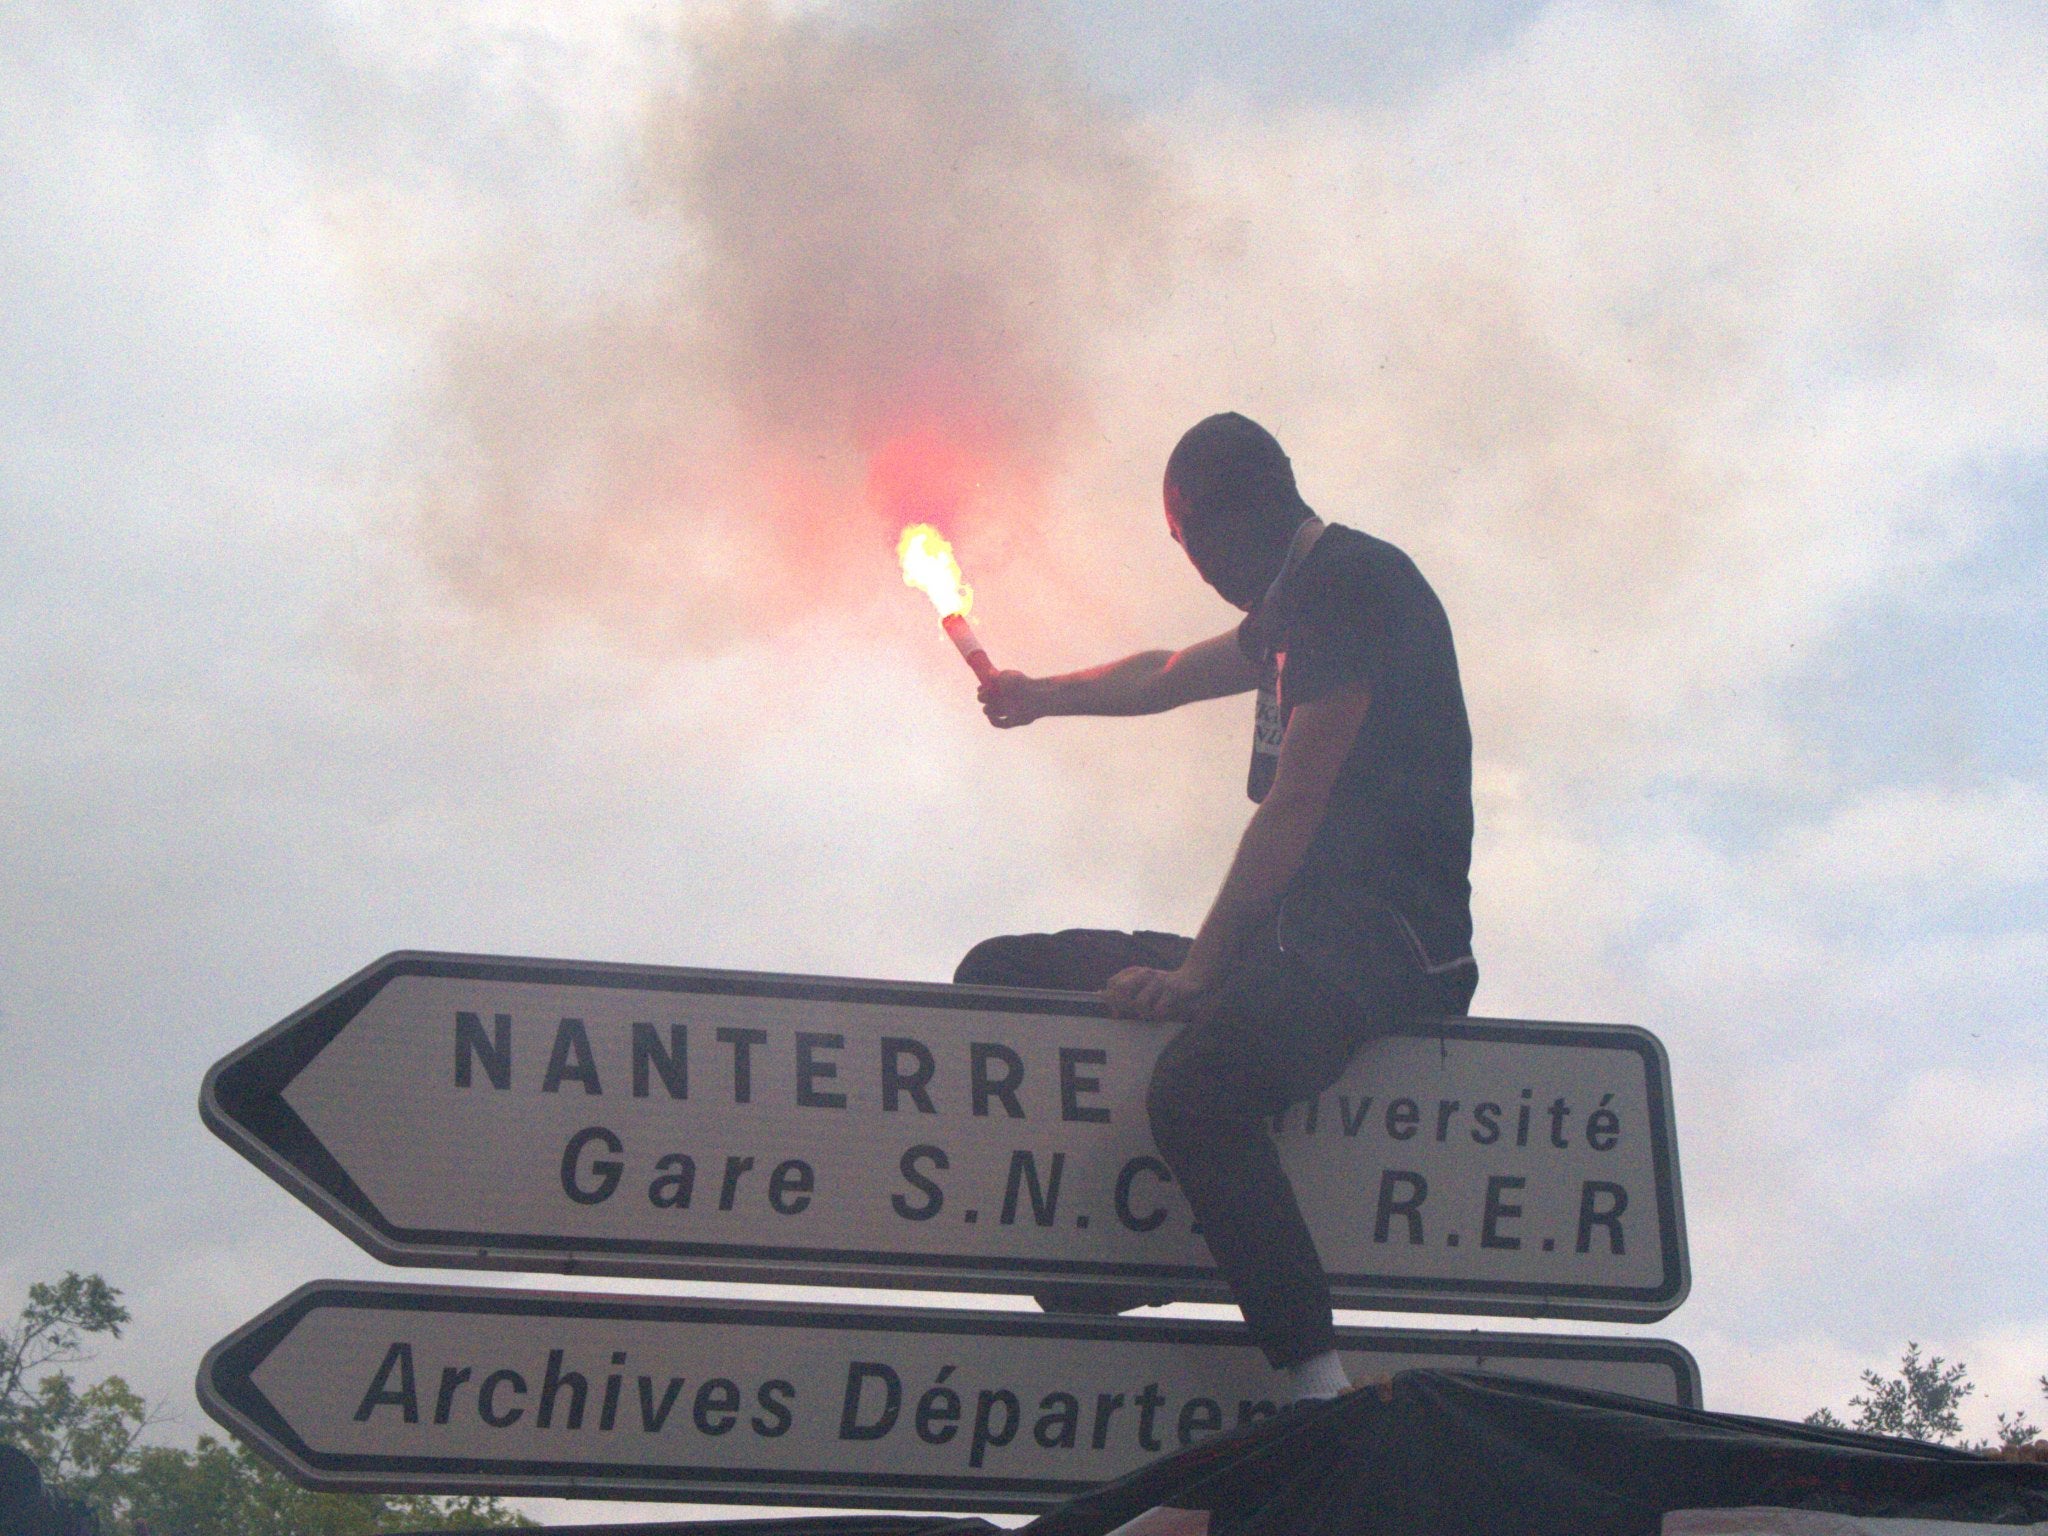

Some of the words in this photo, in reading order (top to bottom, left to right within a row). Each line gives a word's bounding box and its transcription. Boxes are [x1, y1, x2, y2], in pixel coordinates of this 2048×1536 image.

[453, 1009, 1112, 1124] NANTERRE
[1271, 1088, 1621, 1152] iversité
[559, 1126, 815, 1215] Gare
[1373, 1169, 1628, 1256] R.E.R
[352, 1341, 796, 1438] Archives
